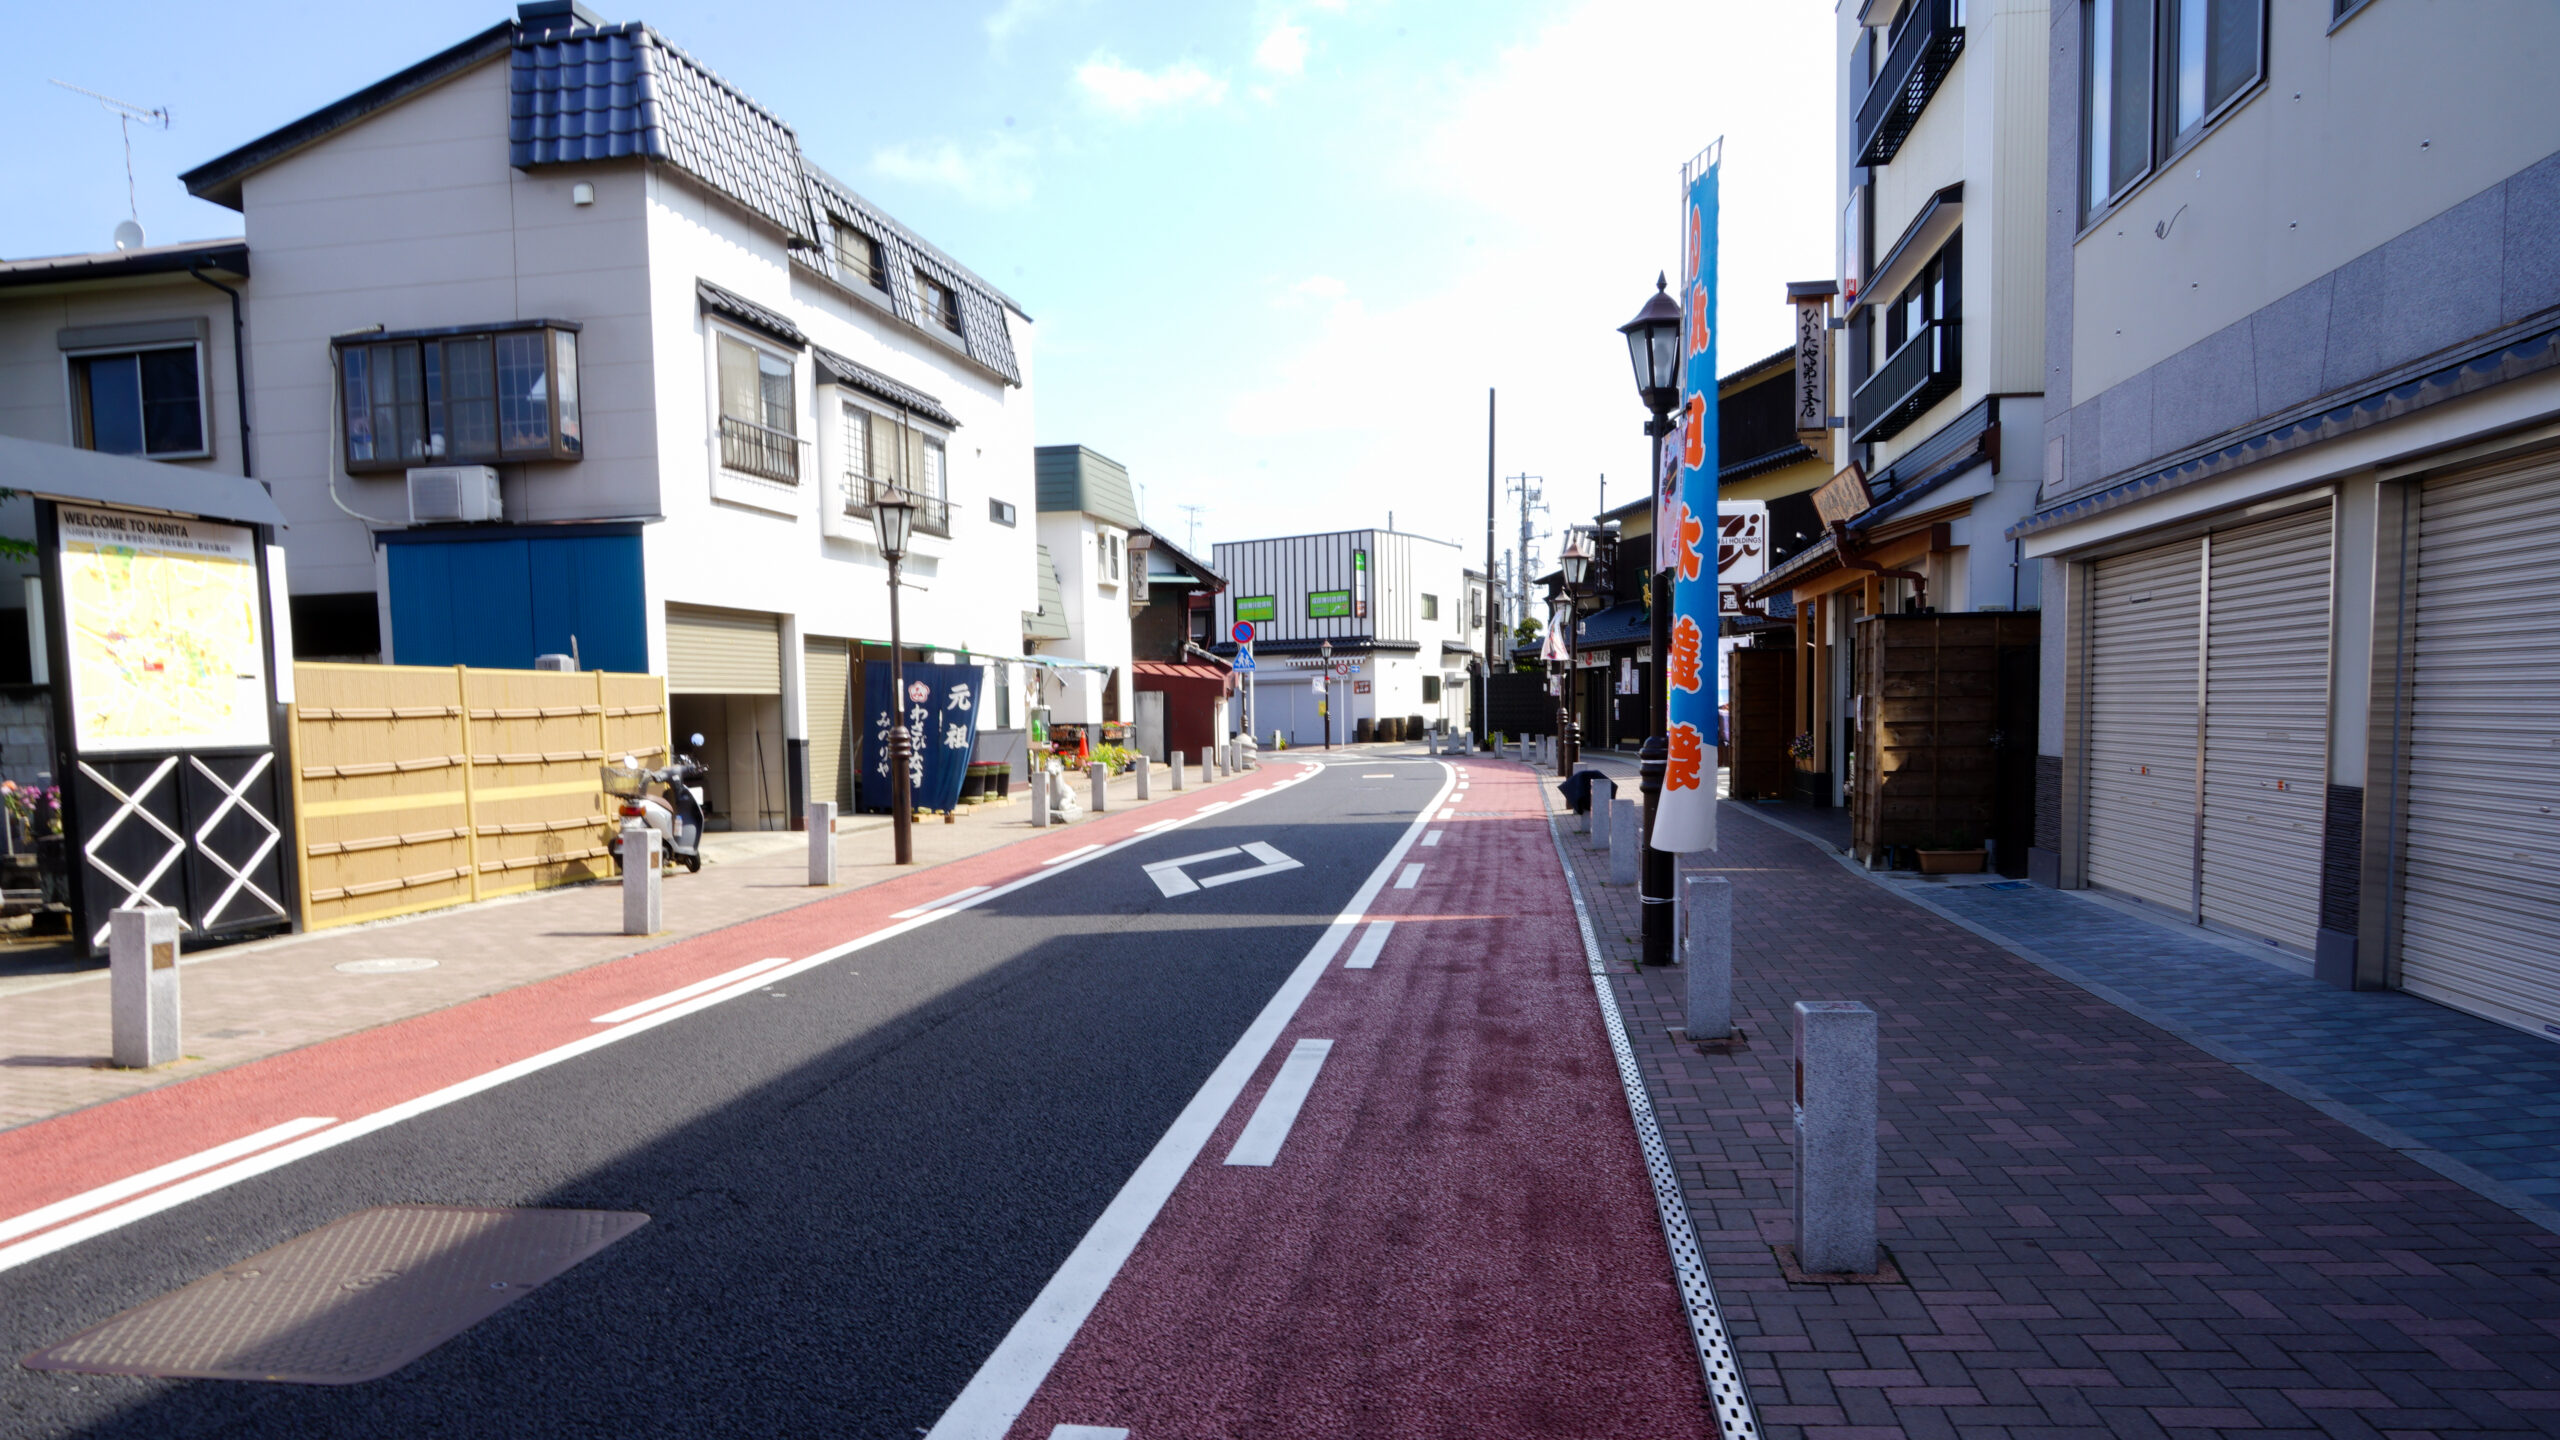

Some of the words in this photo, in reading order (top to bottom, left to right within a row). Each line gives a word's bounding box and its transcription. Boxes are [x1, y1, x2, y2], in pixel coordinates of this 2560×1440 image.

[64, 511, 127, 531] WELCOME
[129, 519, 146, 534] TO
[148, 521, 189, 538] NARITA
[1728, 537, 1762, 545] HOLDINGS
[943, 683, 972, 749] 元祖
